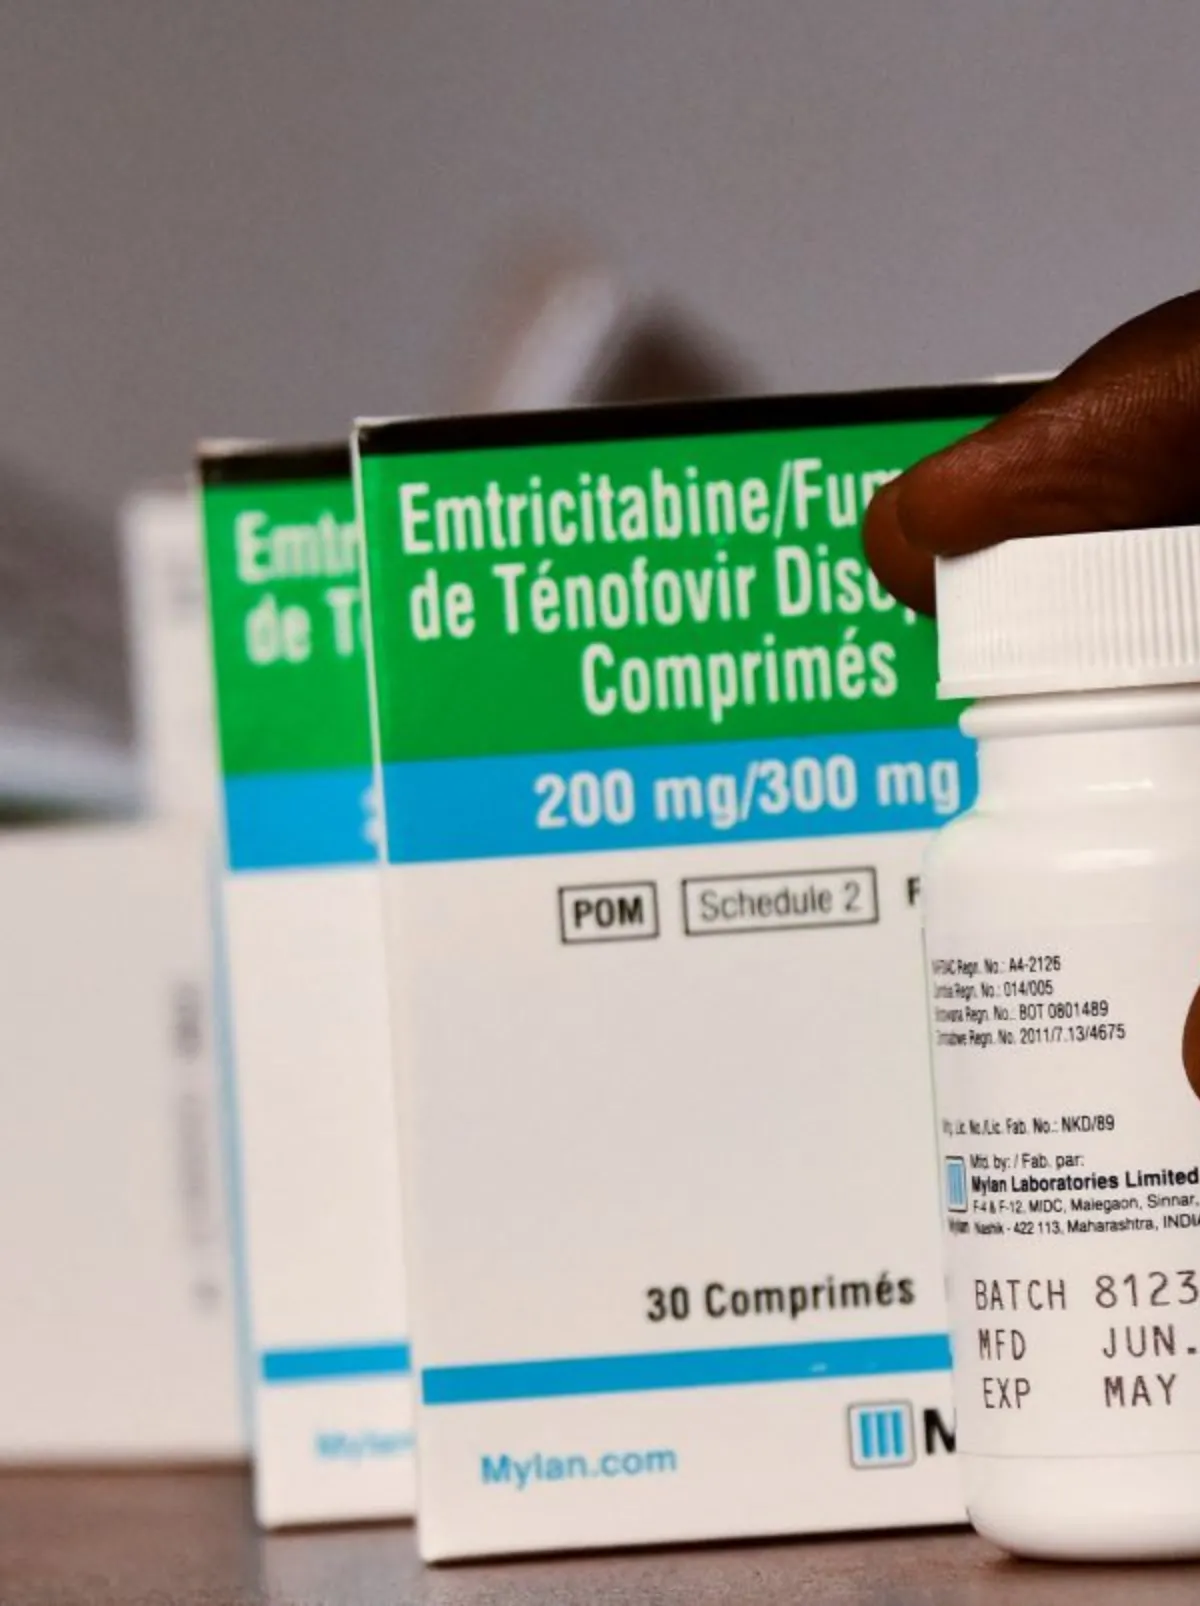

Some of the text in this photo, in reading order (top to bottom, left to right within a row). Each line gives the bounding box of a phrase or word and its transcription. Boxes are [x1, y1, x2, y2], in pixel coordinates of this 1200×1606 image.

[410, 569, 475, 640] de
[492, 552, 756, 634] Ténofovir
[244, 592, 311, 665] de
[582, 627, 899, 724] Comprimés
[534, 755, 959, 830] 200 mg/300 mg
[573, 899, 645, 929] POM
[700, 882, 861, 921] Schedule 2
[1009, 956, 1061, 972] A4-2126
[1004, 980, 1053, 997] 014/005
[1020, 1004, 1045, 1020] BOT
[1048, 1000, 1109, 1018] 0801489
[1020, 1024, 1126, 1044] 2011/7.13/4675
[1062, 1114, 1115, 1132] NKD/89
[993, 1154, 1011, 1171] by:
[1022, 1152, 1051, 1169] Fab.
[1056, 1154, 1084, 1169] par:
[972, 1167, 1199, 1195] Mylan Laboratories Limited
[1029, 1198, 1066, 1213] MIDC,
[1071, 1195, 1143, 1216] Malegaon,
[1147, 1194, 1199, 1209] Sinnar,
[1013, 1219, 1035, 1234] 422
[1067, 1215, 1158, 1234] Maharashtra,
[647, 1273, 916, 1322] 30 Comprimés
[974, 1278, 1066, 1312] BATCH
[979, 1328, 1027, 1361] MFD
[984, 1376, 1030, 1410] EXP
[1105, 1373, 1177, 1408] MAY
[480, 1443, 678, 1490] Mylan.com
